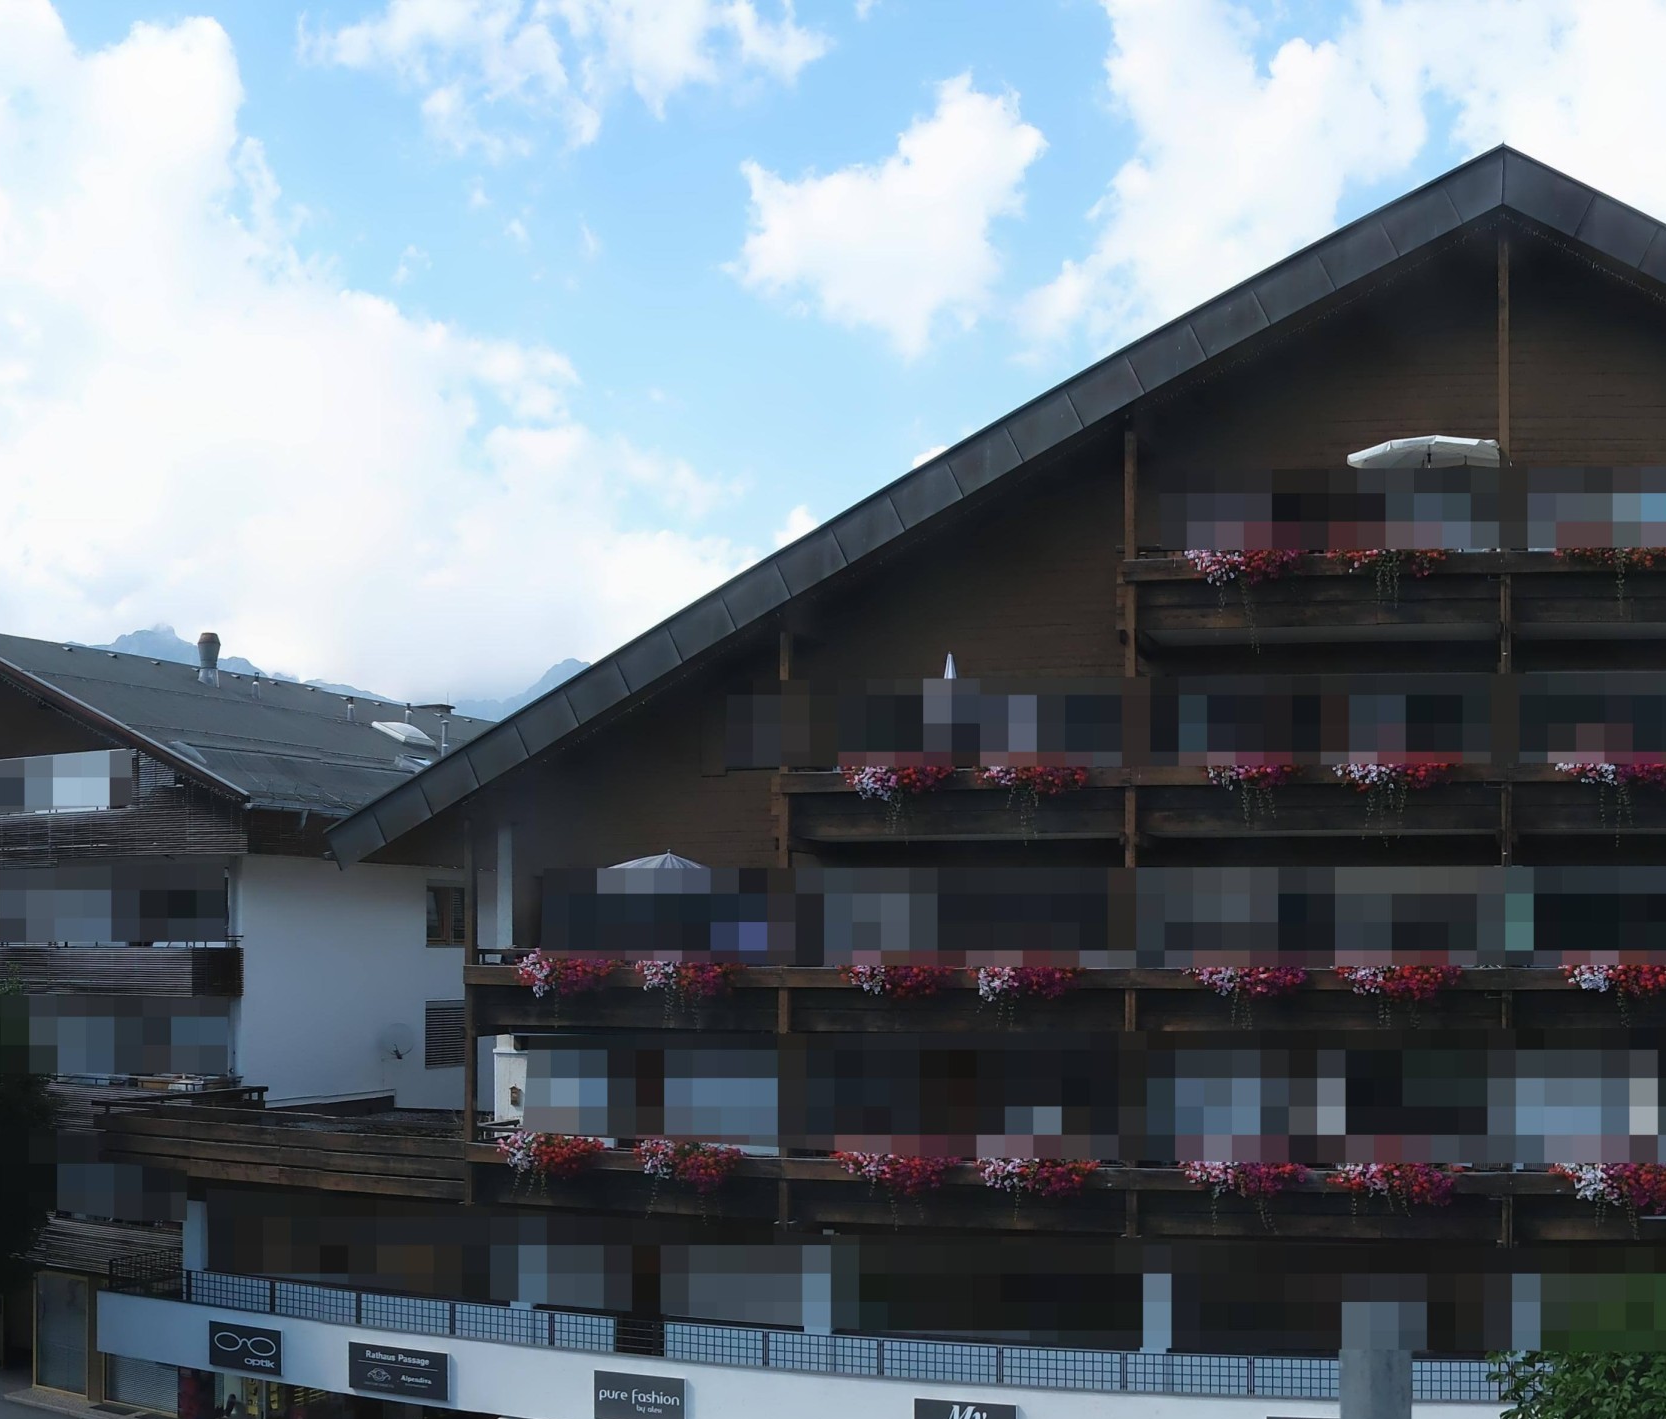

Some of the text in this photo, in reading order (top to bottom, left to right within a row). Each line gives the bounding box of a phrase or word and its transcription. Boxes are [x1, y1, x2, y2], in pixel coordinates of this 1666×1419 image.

[244, 1357, 275, 1369] optik
[365, 1350, 430, 1366] Rathaus Passage
[599, 1388, 680, 1406] pure fashion
